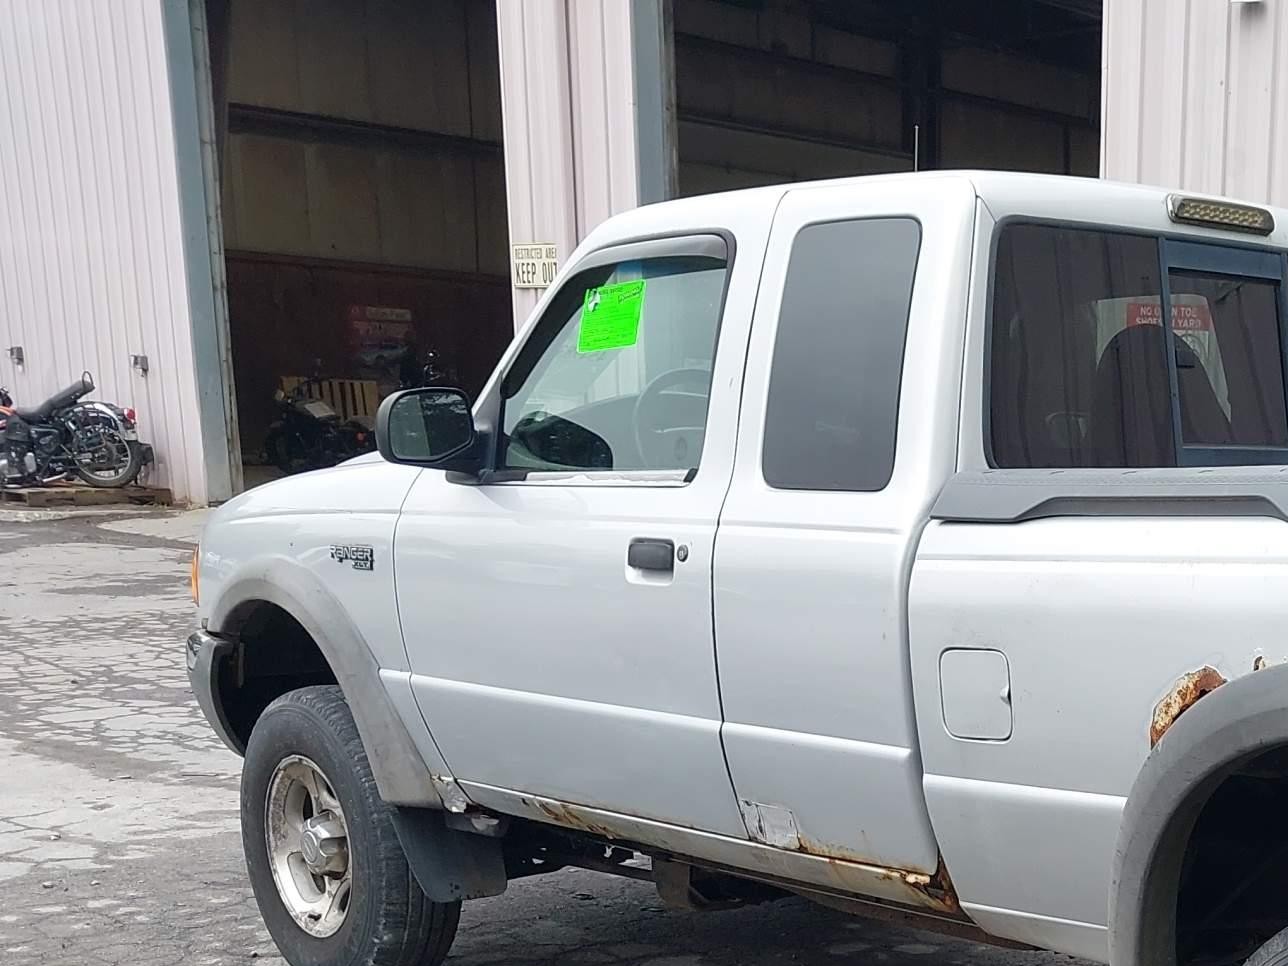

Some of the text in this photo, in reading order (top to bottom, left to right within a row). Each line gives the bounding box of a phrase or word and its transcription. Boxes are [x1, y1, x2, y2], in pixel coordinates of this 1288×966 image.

[514, 247, 542, 260] RESTRICTED
[515, 261, 558, 284] KEEP OUT
[1140, 306, 1152, 317] NO
[329, 545, 371, 561] RANGER
